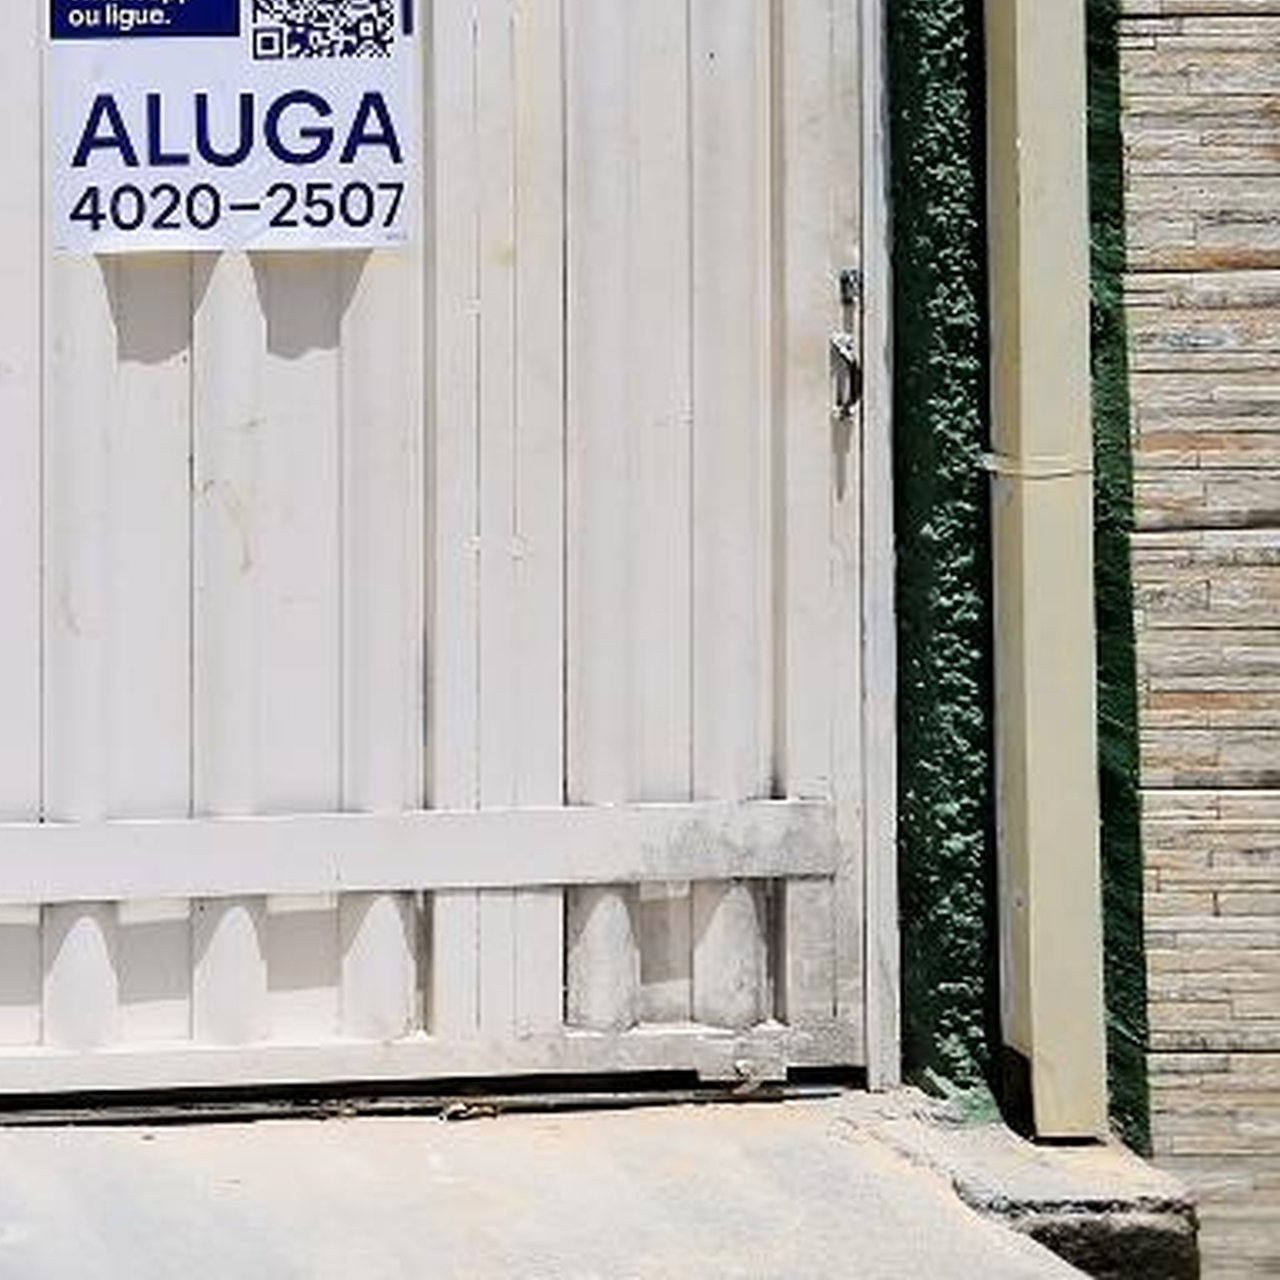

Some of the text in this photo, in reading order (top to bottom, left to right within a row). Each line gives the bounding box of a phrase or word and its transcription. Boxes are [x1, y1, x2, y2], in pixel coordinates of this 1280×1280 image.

[68, 3, 172, 31] ou ligue.
[71, 90, 403, 167] ALUGA
[68, 181, 405, 231] 4020-2507
